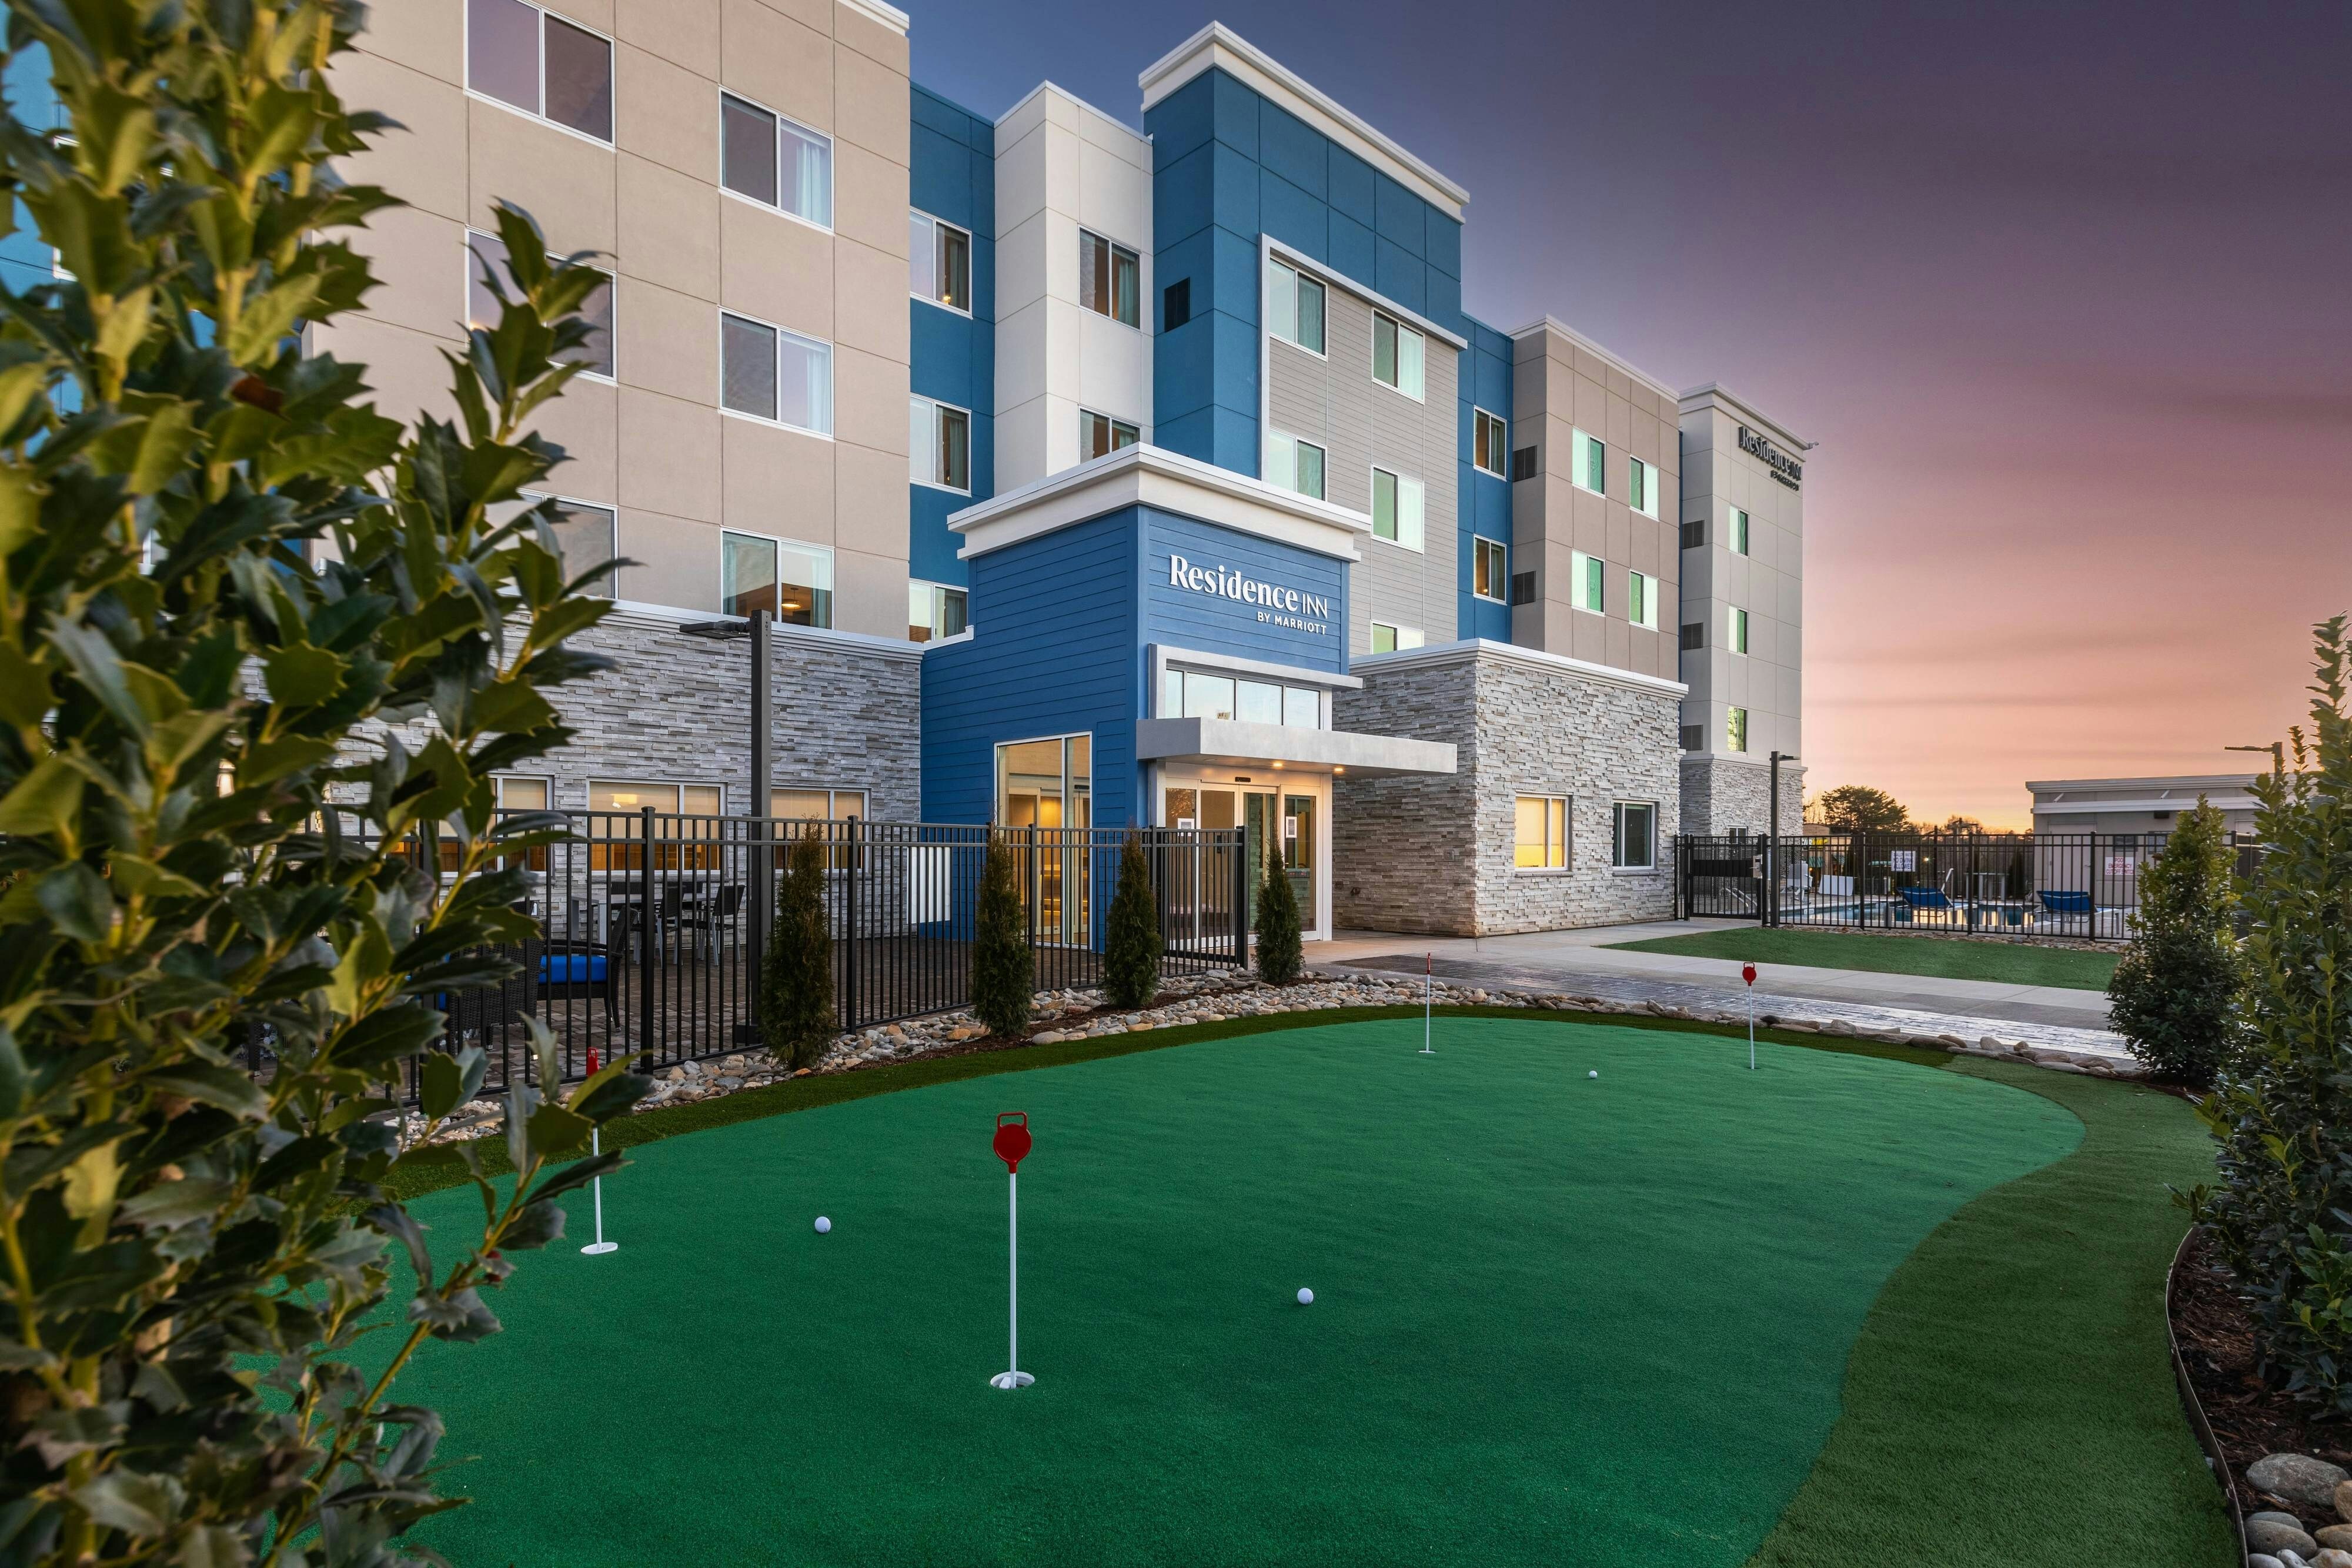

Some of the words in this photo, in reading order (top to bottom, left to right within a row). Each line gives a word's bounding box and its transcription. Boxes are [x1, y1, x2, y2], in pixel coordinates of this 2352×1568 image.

[1739, 426, 1790, 472] Residence
[1170, 554, 1298, 611] Residence
[1302, 593, 1328, 619] INN
[1257, 611, 1271, 623] BY
[1274, 615, 1327, 635] MARRIOTT
